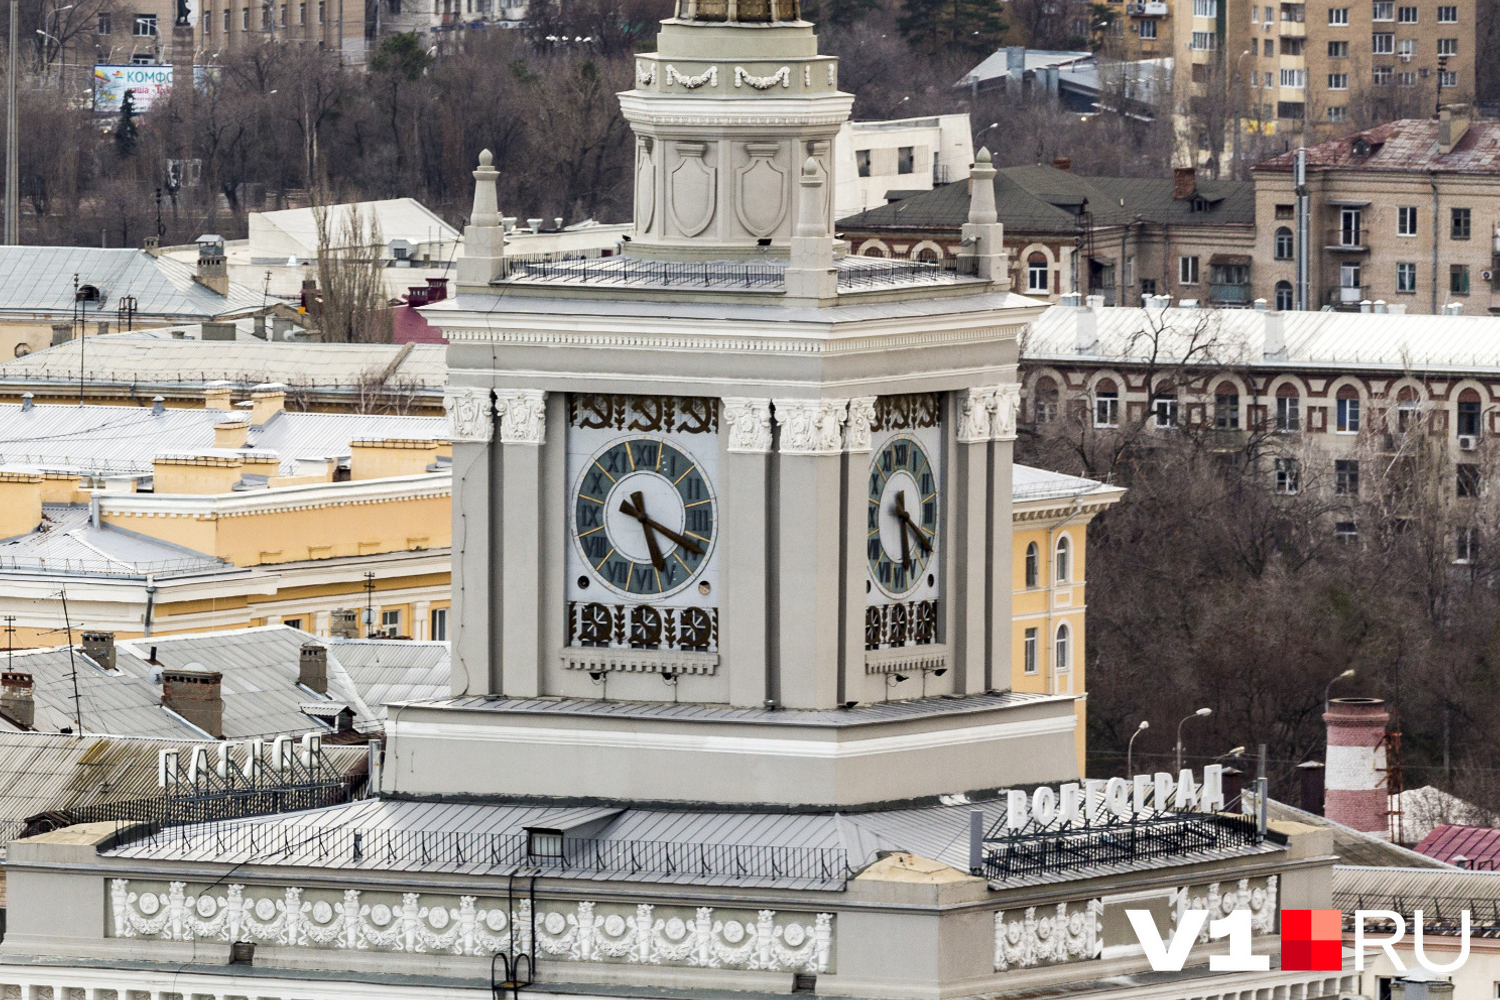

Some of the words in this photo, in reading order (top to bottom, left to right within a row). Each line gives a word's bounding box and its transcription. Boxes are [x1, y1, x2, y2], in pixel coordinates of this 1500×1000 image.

[607, 452, 627, 474] XI
[636, 444, 657, 467] XII
[882, 450, 892, 472] XI
[590, 473, 603, 495] X
[687, 478, 700, 500] II
[922, 473, 930, 494] II
[581, 505, 600, 527] IX
[692, 509, 709, 532] III
[924, 502, 933, 524] III
[584, 536, 607, 559] VIII
[607, 560, 627, 583] VII
[635, 568, 653, 591] VI
[663, 562, 676, 586] V
[1007, 764, 1224, 829] ВОЛГОГРАД
